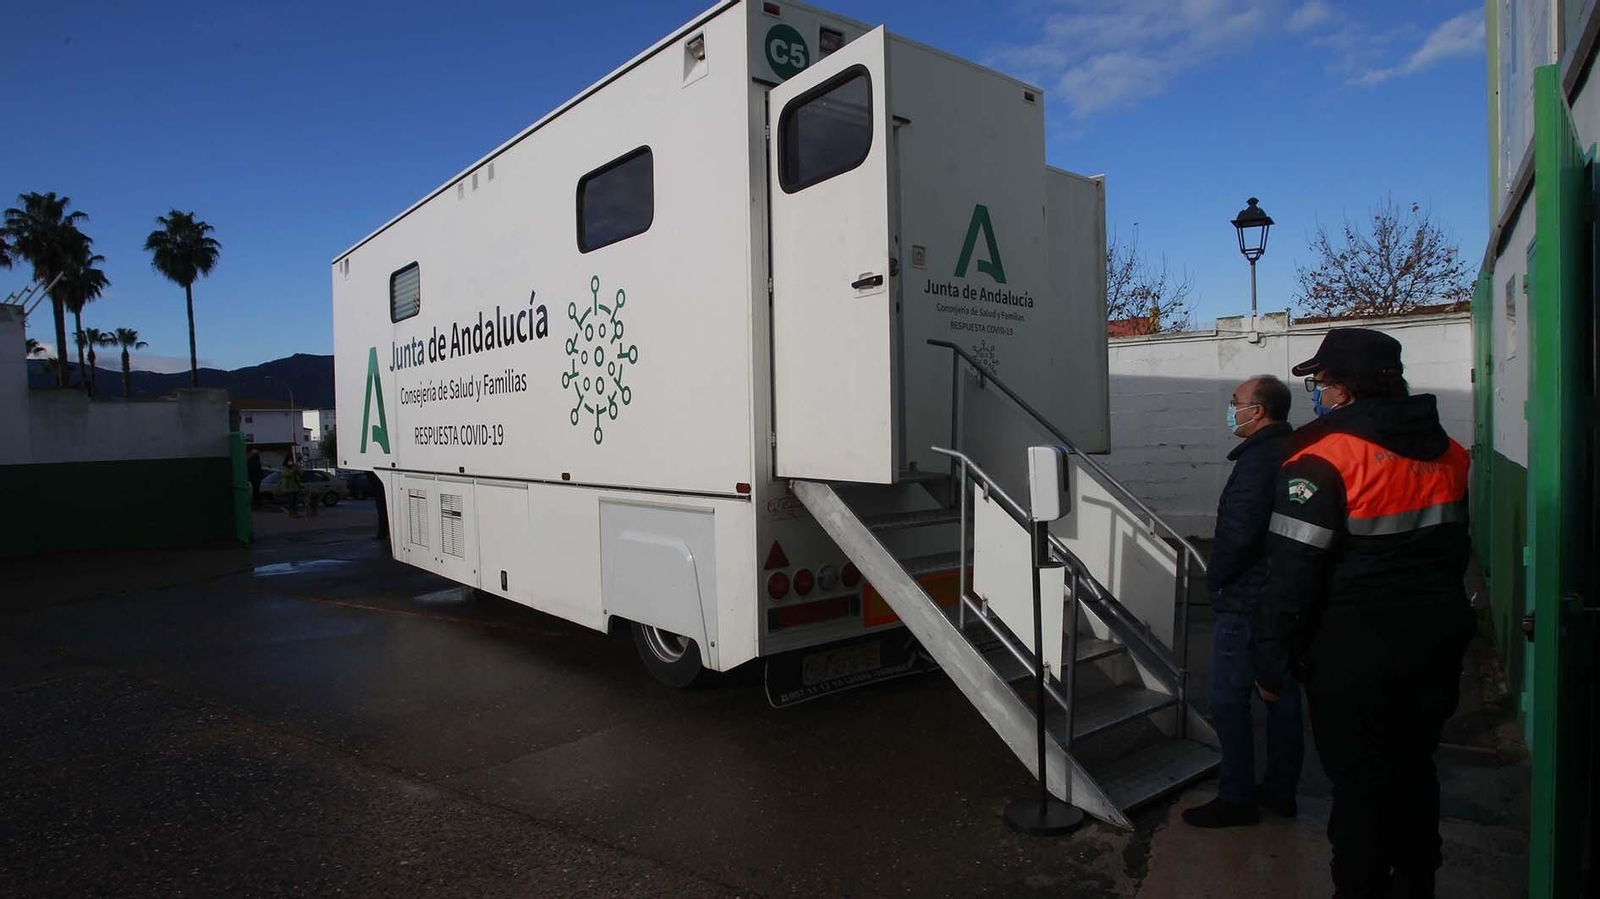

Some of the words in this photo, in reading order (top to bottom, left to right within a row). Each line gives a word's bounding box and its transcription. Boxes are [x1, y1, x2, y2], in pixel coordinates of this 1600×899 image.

[770, 38, 806, 69] C5
[924, 279, 960, 298] Junta
[962, 284, 977, 300] de
[979, 287, 1034, 308] Andalucía
[936, 303, 970, 316] Consejería
[971, 307, 979, 316] de
[979, 308, 997, 319] Salud
[996, 312, 1001, 321] y
[1001, 311, 1025, 322] Familias
[389, 336, 425, 372] Junta
[428, 326, 447, 363] de
[450, 290, 549, 359] Andalucía
[950, 321, 986, 333] RESPUESTA
[986, 325, 1014, 336] COVID-19
[400, 380, 437, 408] Consejería
[437, 380, 448, 401] de
[449, 375, 474, 399] Salud
[475, 380, 482, 402] y
[484, 368, 527, 395] Familias
[414, 425, 459, 445] RESPUESTA
[460, 424, 505, 446] COVID-19
